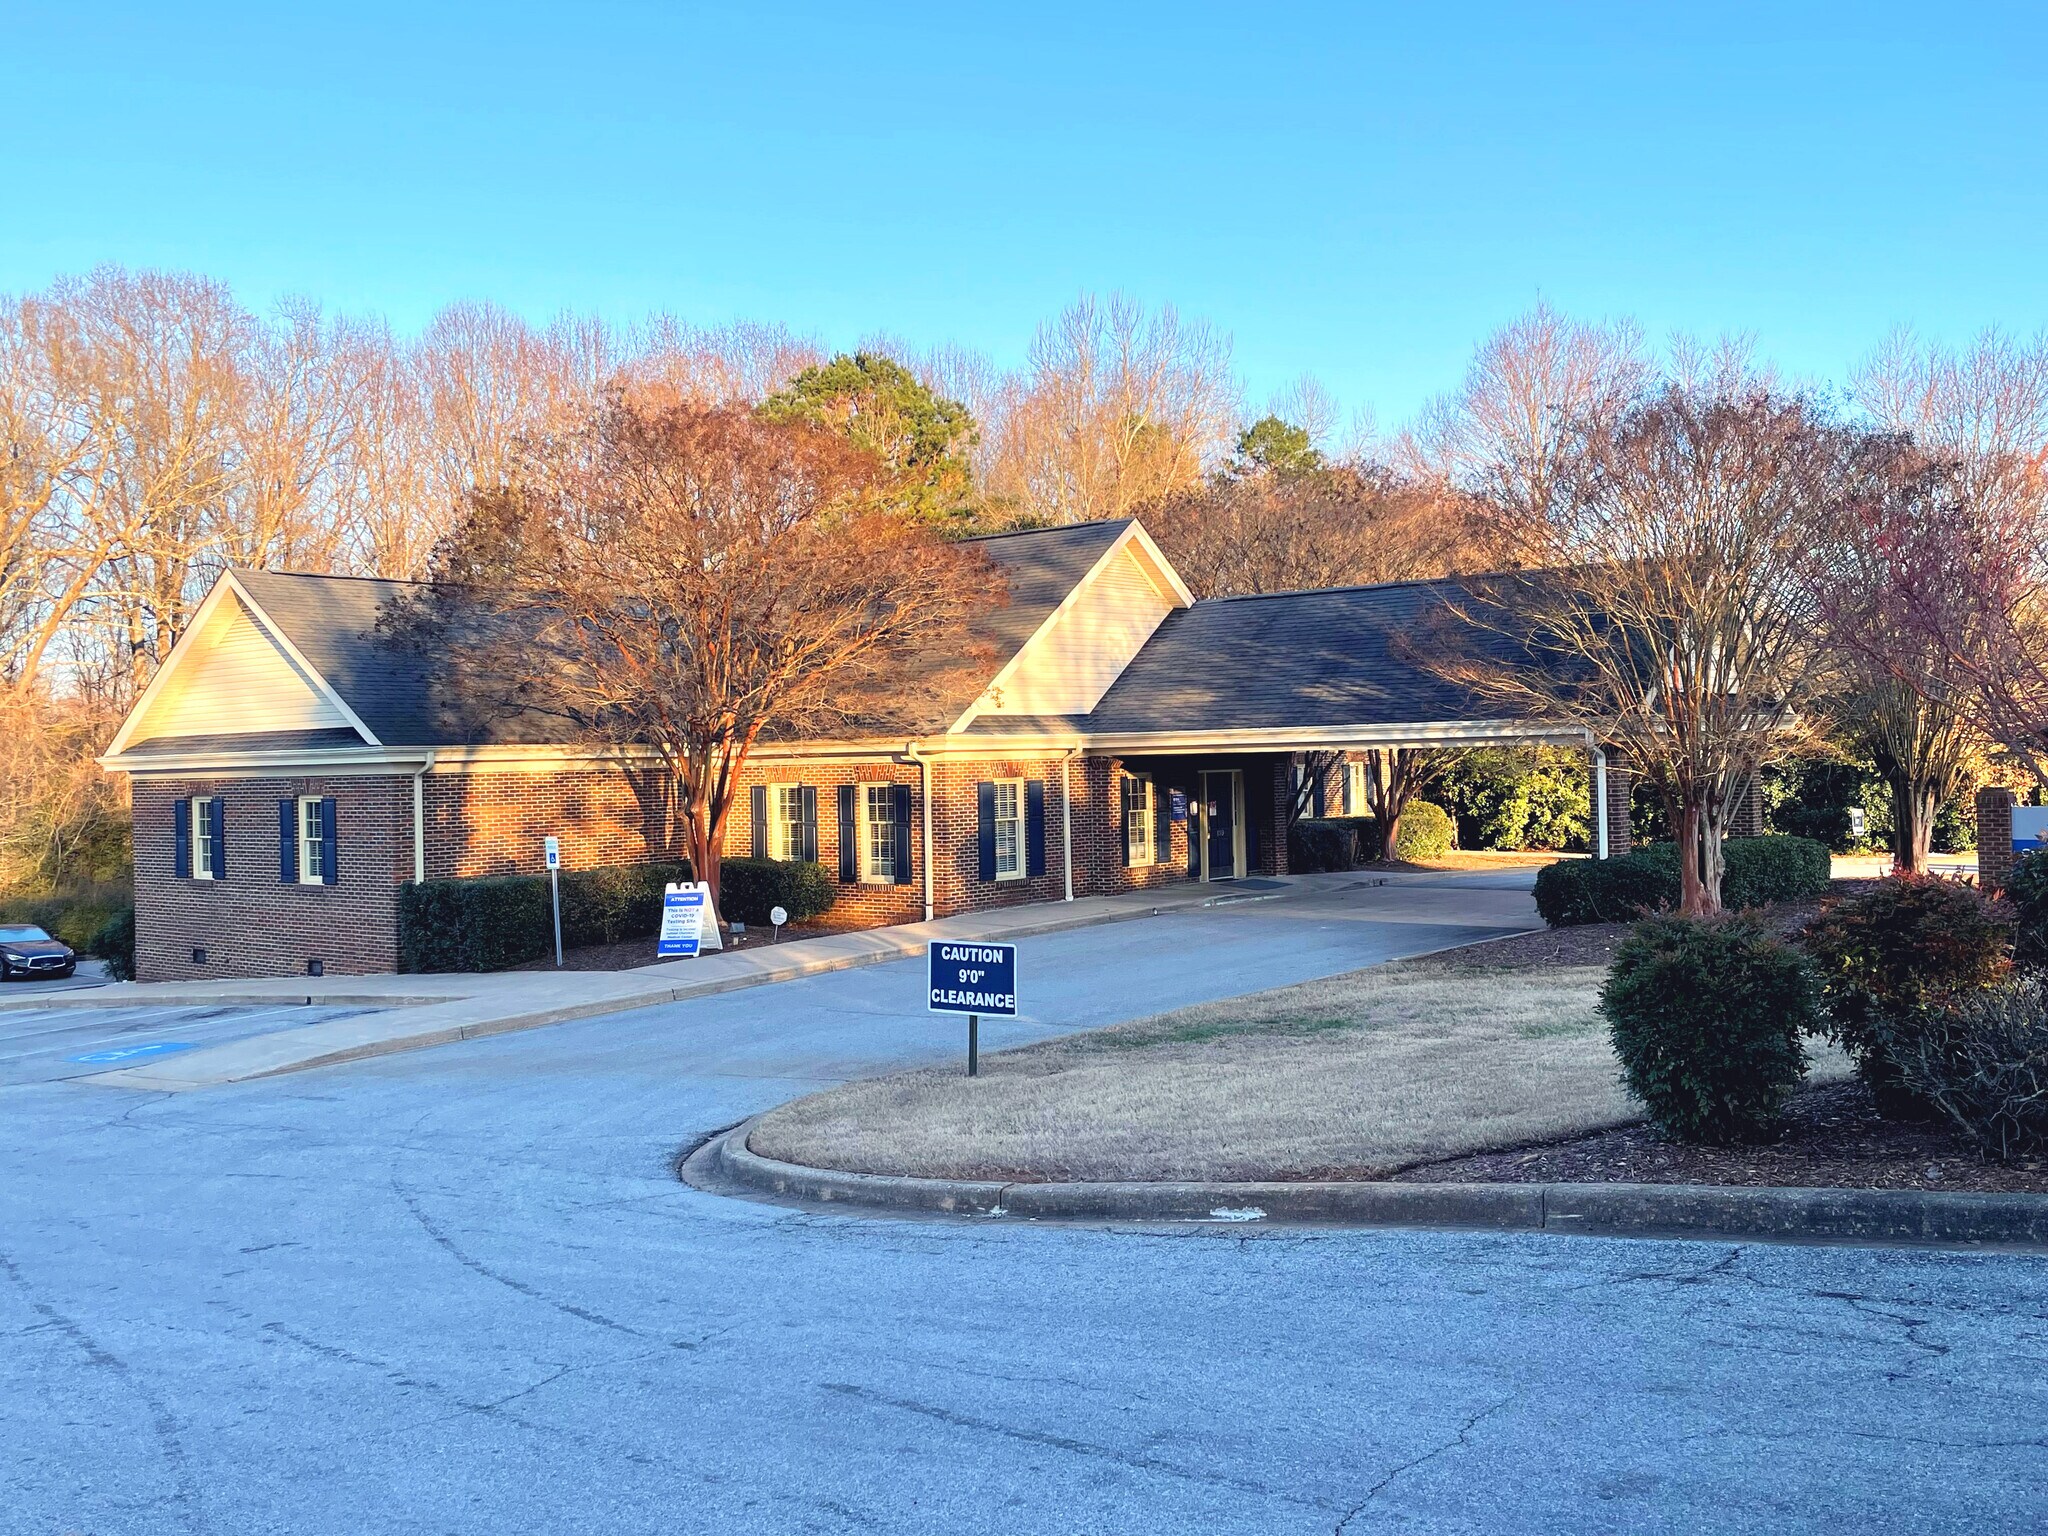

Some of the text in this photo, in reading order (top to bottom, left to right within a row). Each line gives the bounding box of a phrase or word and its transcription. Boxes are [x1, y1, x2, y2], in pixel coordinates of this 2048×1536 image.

[941, 946, 1003, 963] CAUTION
[959, 969, 985, 984] 9'0"
[931, 988, 1015, 1009] CLEARANCE
